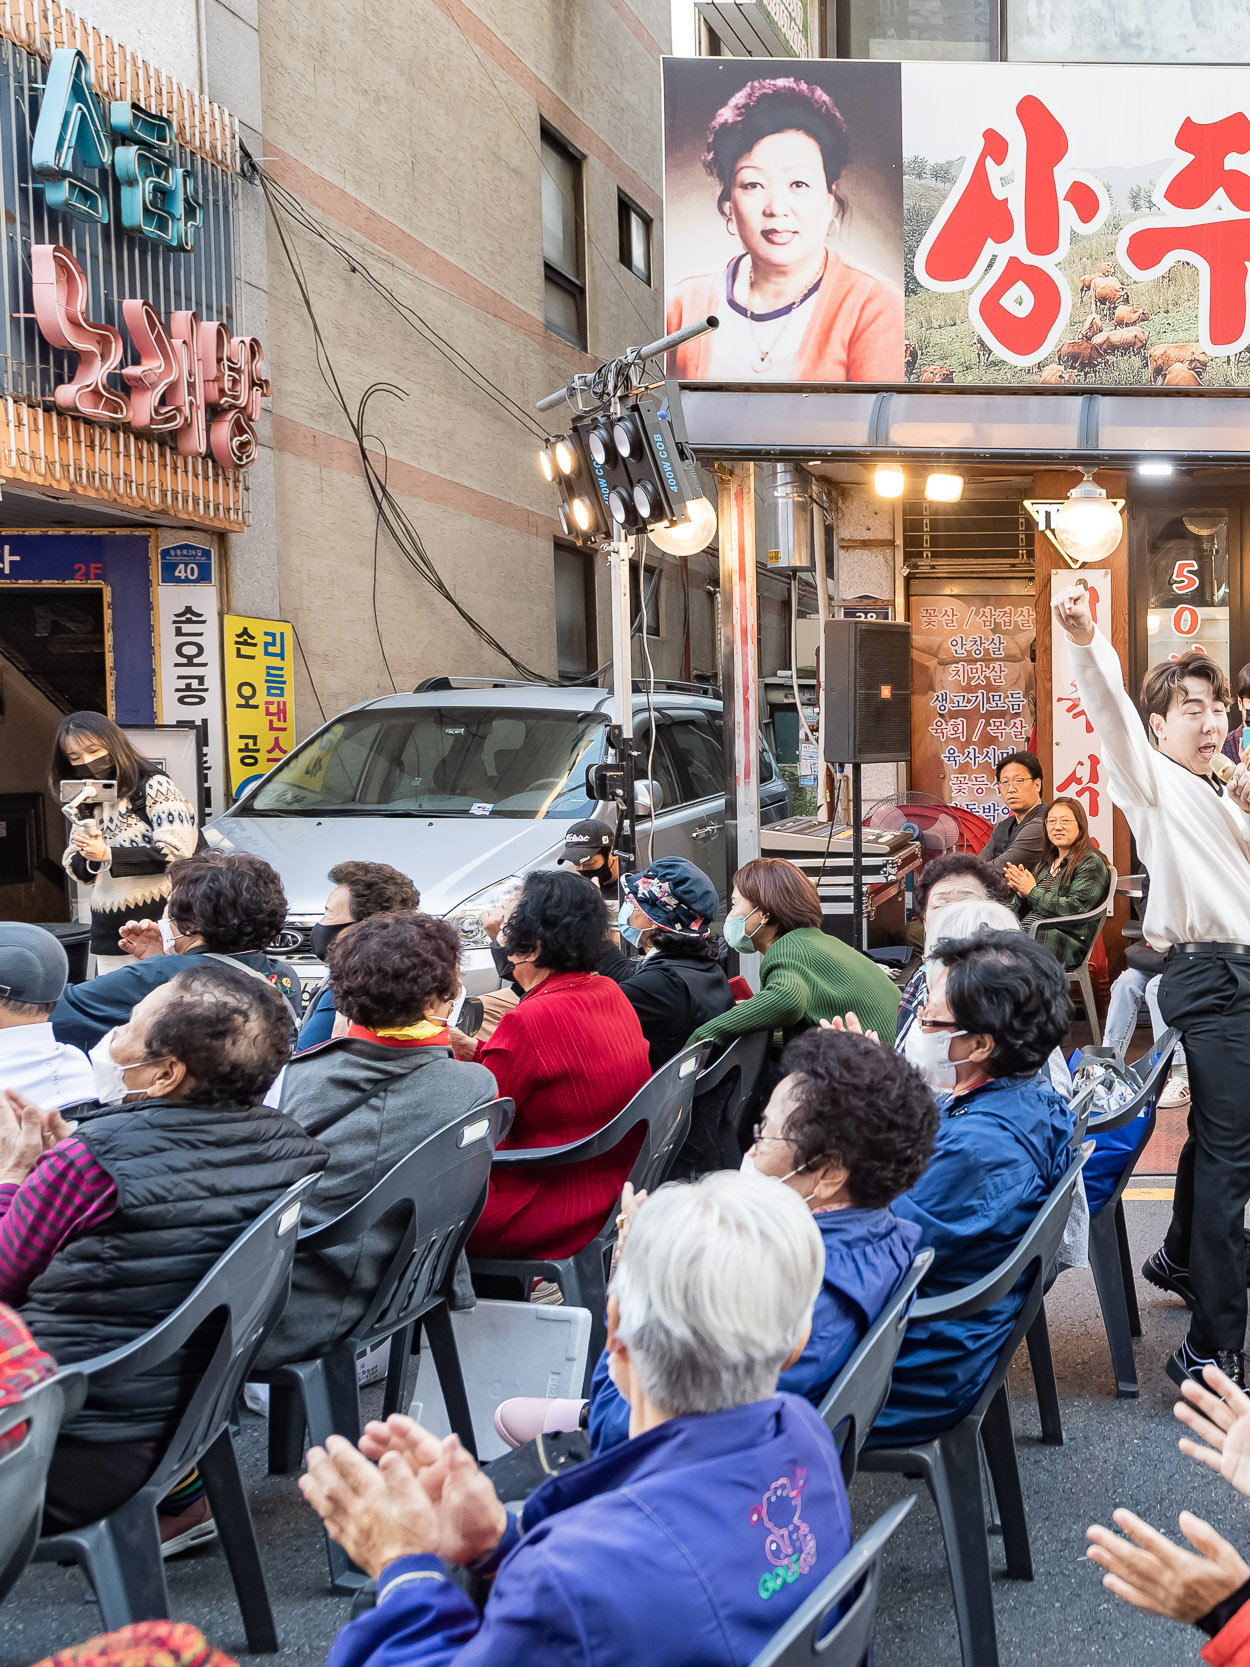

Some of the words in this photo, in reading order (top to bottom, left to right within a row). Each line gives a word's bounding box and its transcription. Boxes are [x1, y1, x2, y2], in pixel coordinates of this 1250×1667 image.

[31, 244, 271, 468] 노래방
[653, 433, 668, 459] COB
[591, 453, 604, 476] CO
[661, 460, 678, 493] 400W
[74, 563, 104, 580] 2F
[174, 563, 199, 580] 40
[920, 607, 958, 630] 꽃살
[977, 606, 1035, 629] 삼겹살
[171, 605, 210, 707] 손오공
[950, 635, 1006, 658] 안창살
[949, 662, 1006, 685] 치맛살
[233, 626, 261, 768] 손오공
[263, 631, 289, 763] 리듬댄스
[931, 690, 1026, 713] 생고기모듬
[930, 719, 966, 741] 육회
[987, 720, 1028, 741] 목살
